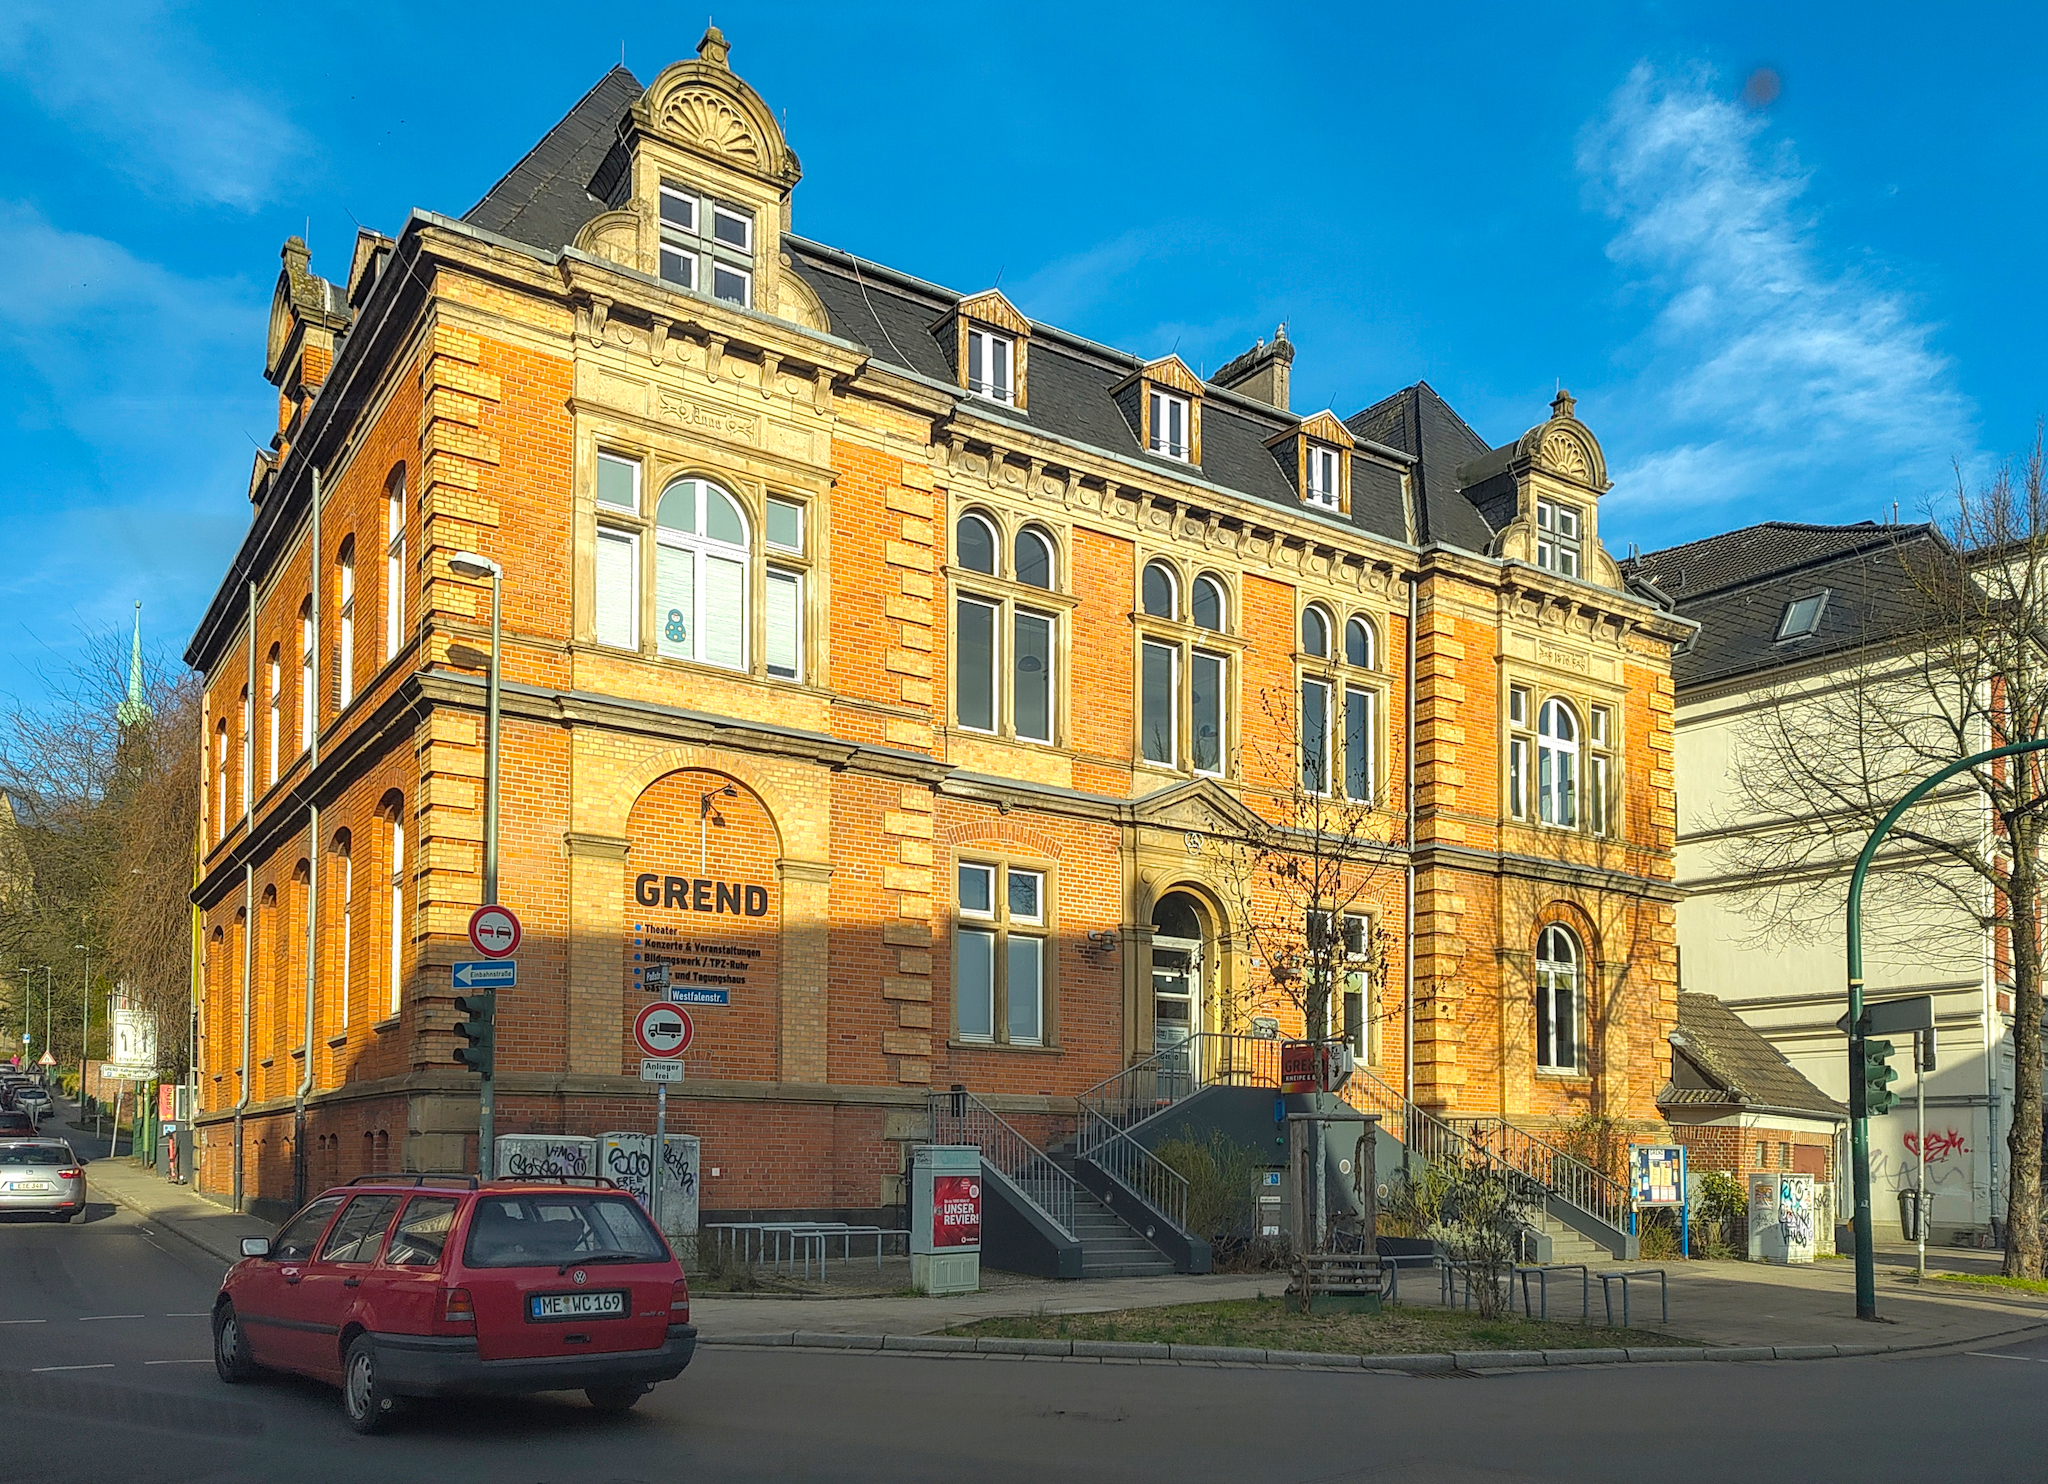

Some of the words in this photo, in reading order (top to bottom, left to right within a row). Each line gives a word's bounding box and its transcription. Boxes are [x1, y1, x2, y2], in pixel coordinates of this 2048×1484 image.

[635, 873, 768, 917] GREND
[645, 924, 678, 936] Theater
[645, 939, 683, 951] Konzerte
[685, 942, 692, 951] &
[694, 942, 761, 958] Veranstaltungen
[644, 953, 700, 966] Bildungswerk
[702, 957, 707, 968] /
[710, 958, 749, 970] TPZ-Ruhr
[470, 970, 512, 978] Einbahnstraße
[675, 971, 690, 980] und
[693, 972, 746, 984] Tagungshaus
[672, 990, 723, 1003] Westfalenstr.
[645, 1063, 679, 1072] Anlieger
[655, 1072, 669, 1080] frei
[1285, 1074, 1305, 1082] KNEIPE
[165, 1087, 173, 1111] GREND
[943, 1203, 975, 1215] UNSER
[943, 1213, 979, 1226] REVIER!
[542, 1297, 563, 1314] ME
[572, 1296, 592, 1312] WC
[594, 1295, 621, 1311] 169
